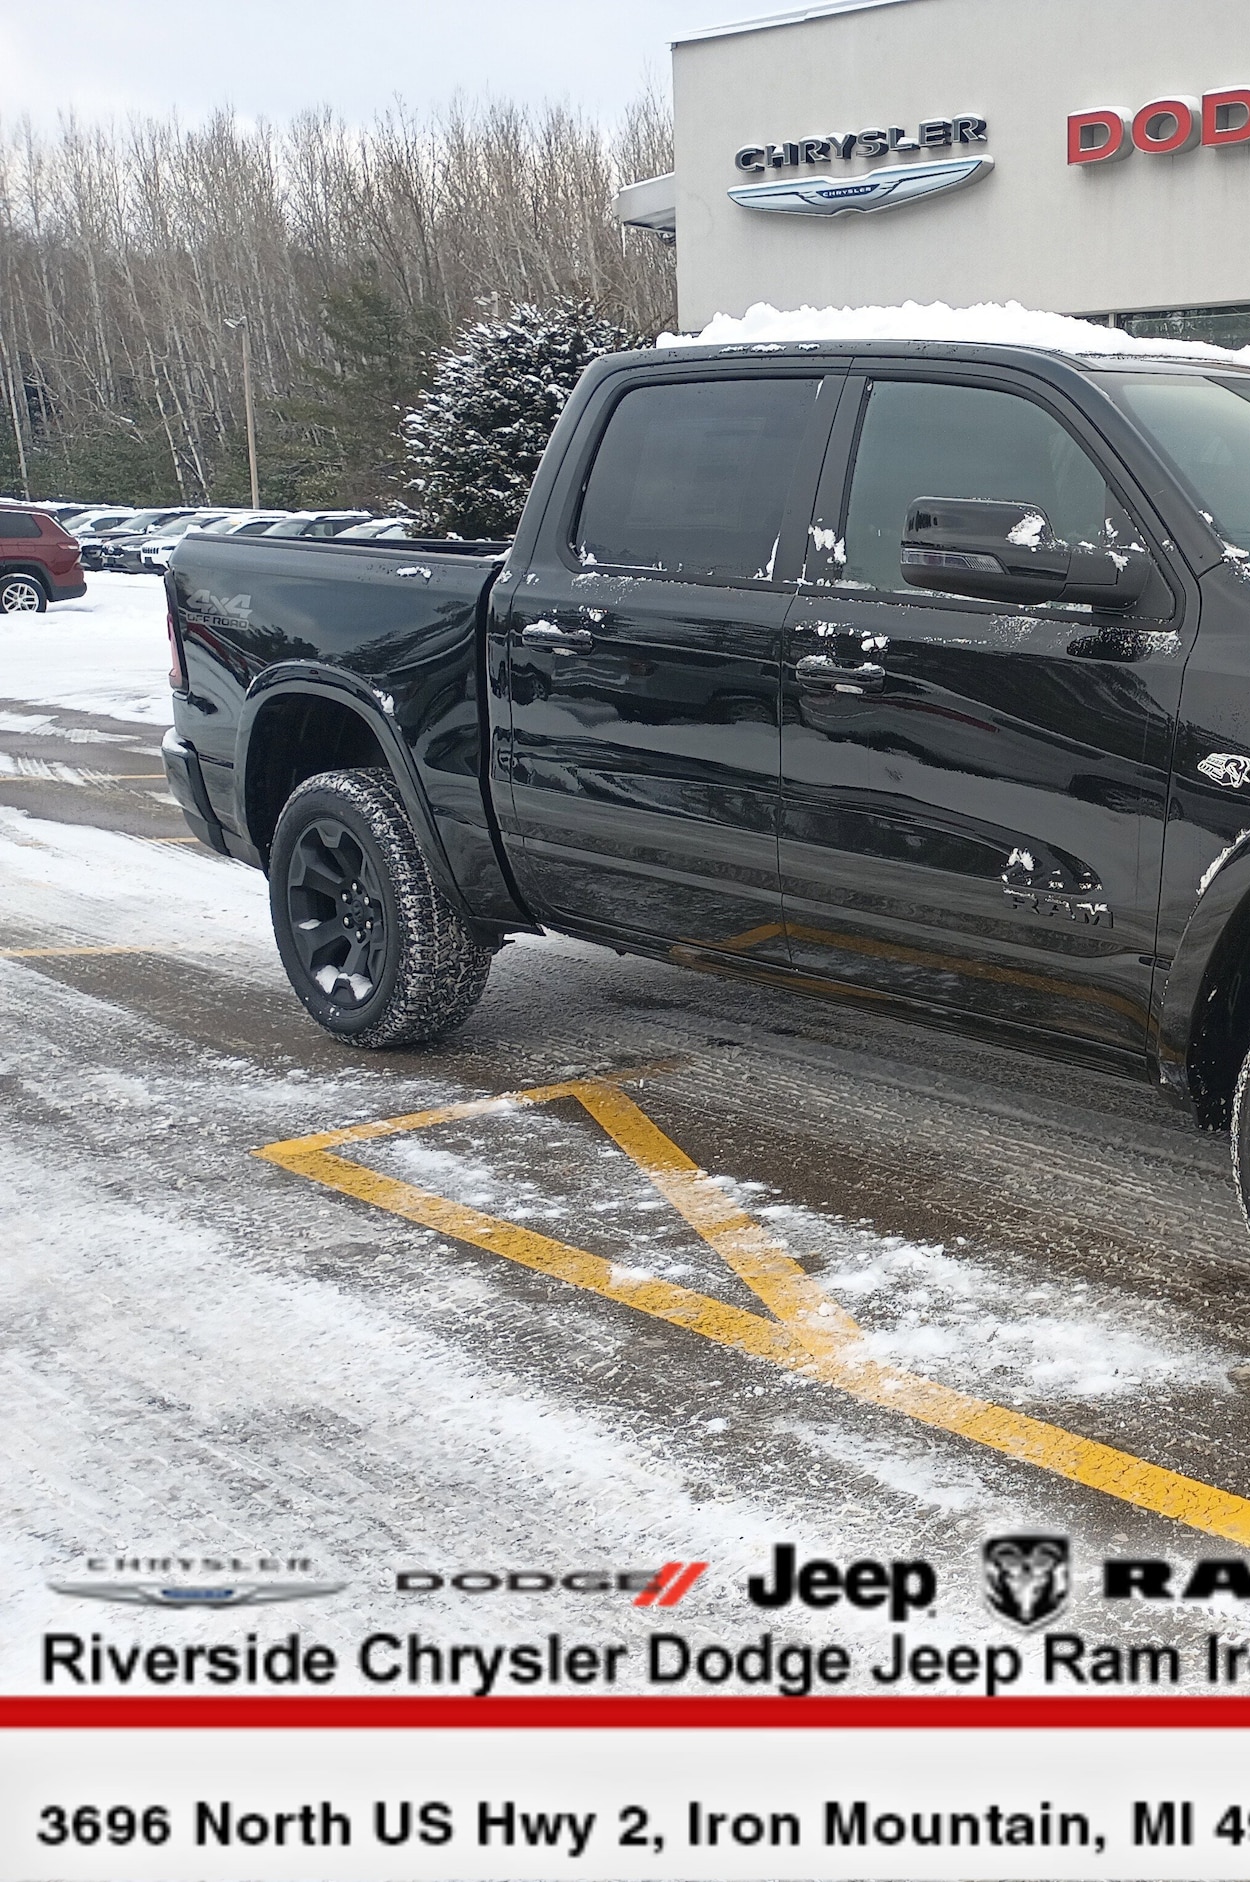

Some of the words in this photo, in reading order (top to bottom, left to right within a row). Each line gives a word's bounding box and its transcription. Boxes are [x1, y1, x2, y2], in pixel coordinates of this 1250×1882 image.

[735, 114, 988, 172] CHRYSLER
[822, 186, 873, 198] CHRYSLER
[187, 613, 210, 624] OFF
[212, 617, 248, 629] ROAD
